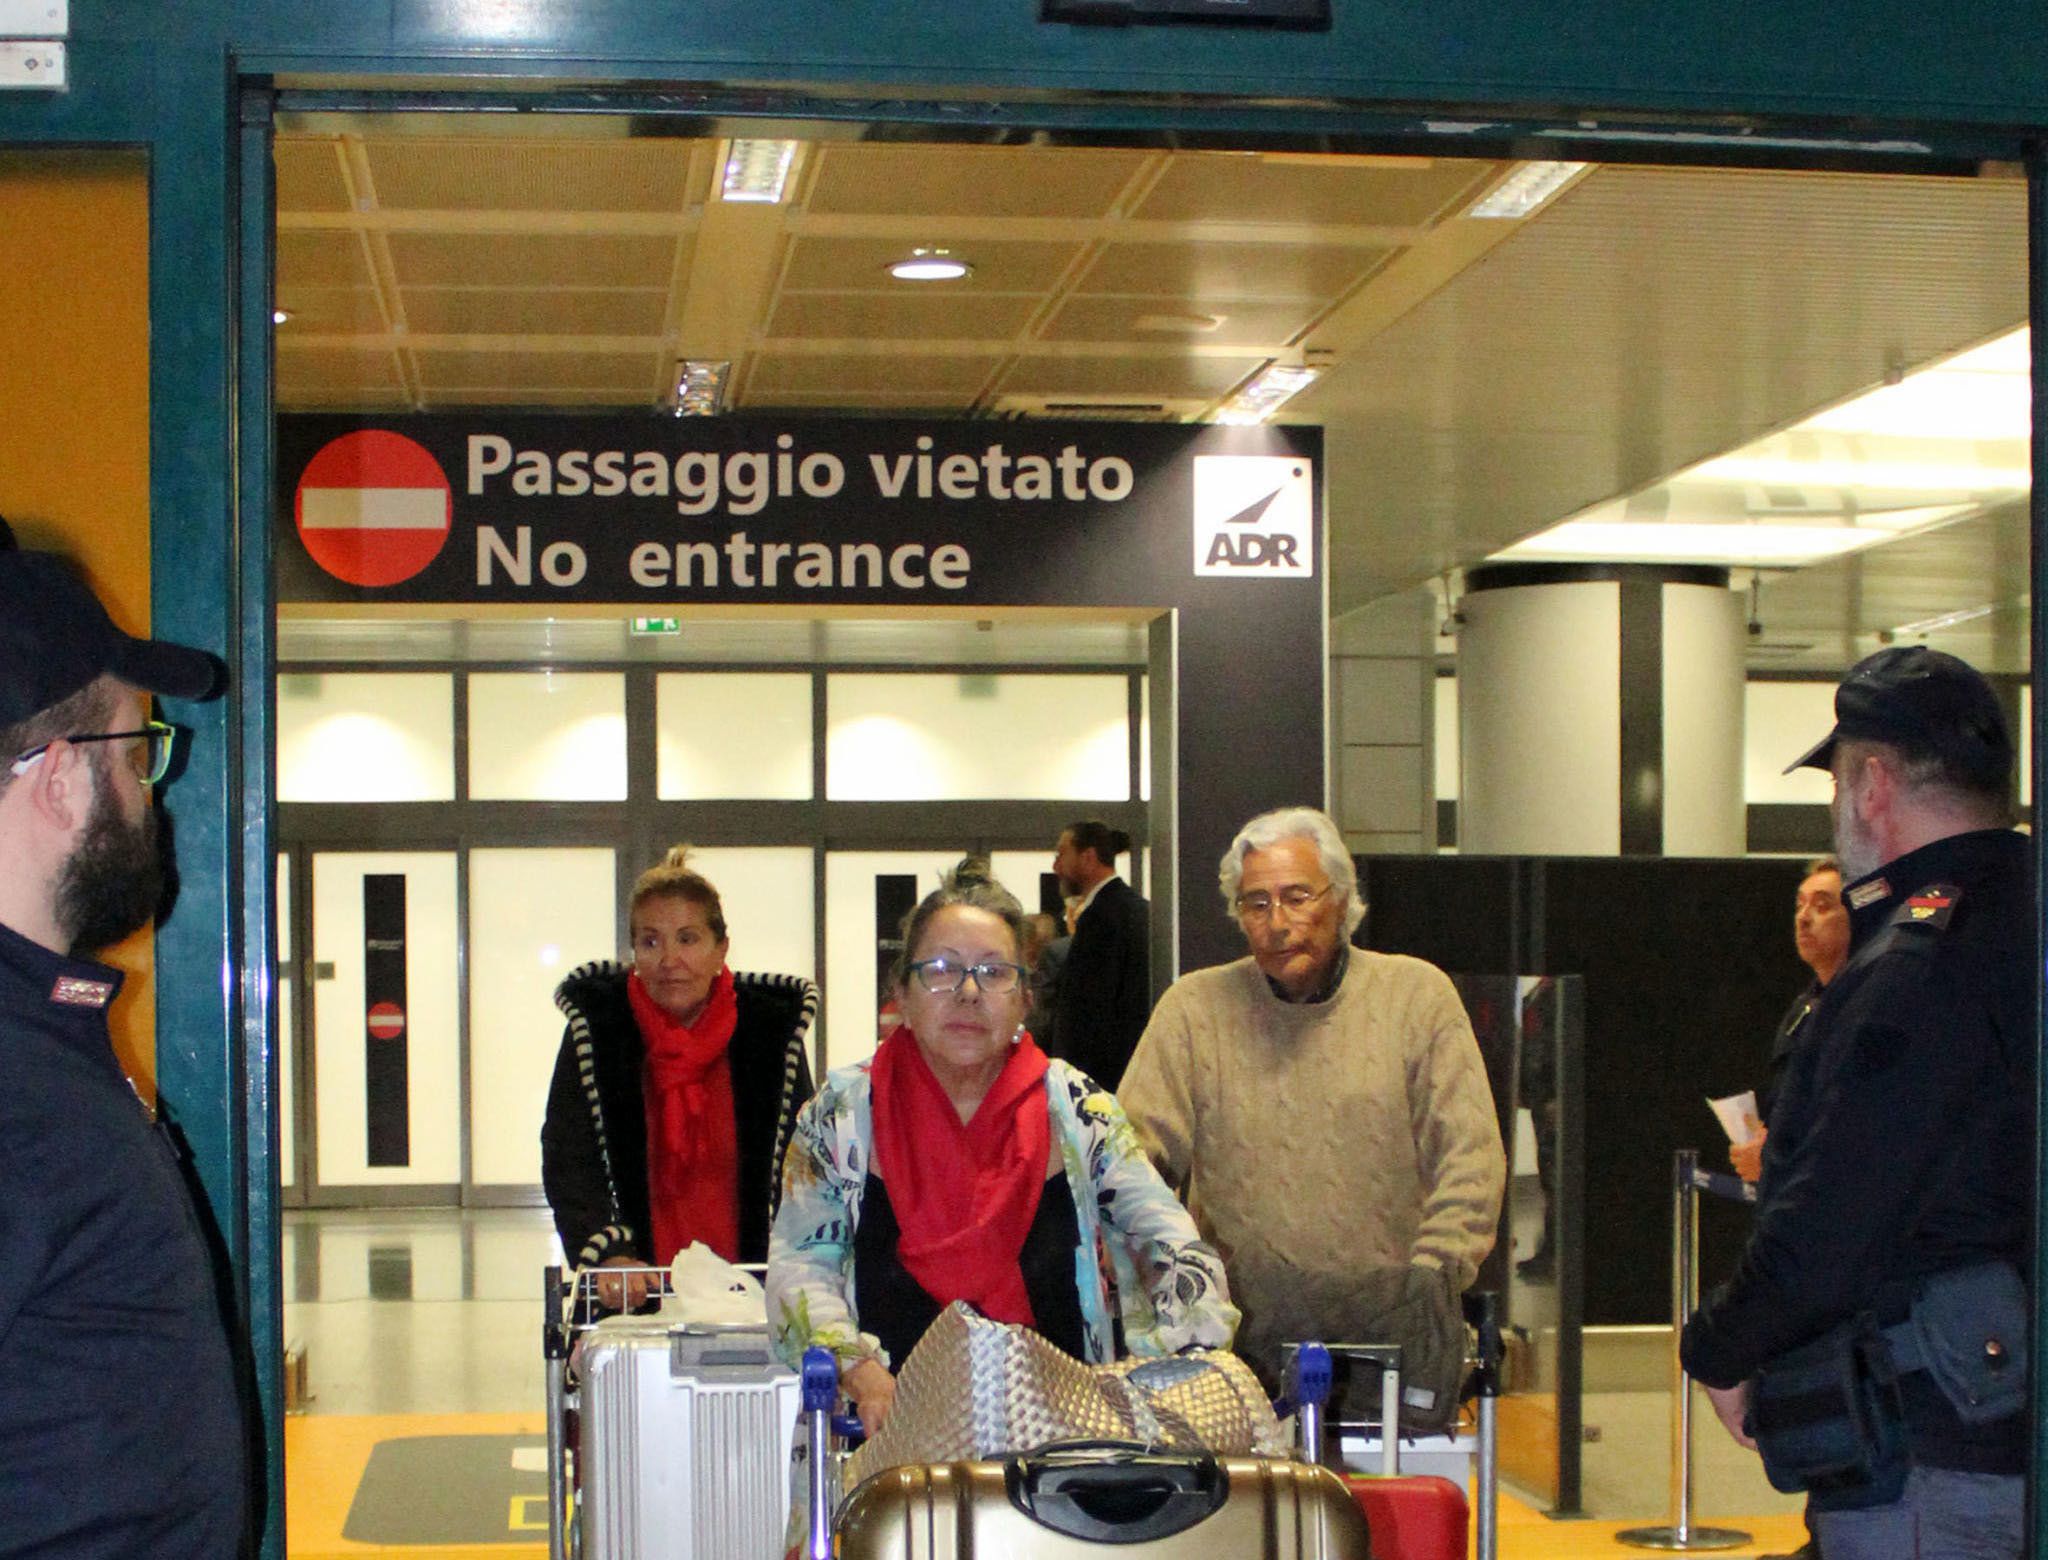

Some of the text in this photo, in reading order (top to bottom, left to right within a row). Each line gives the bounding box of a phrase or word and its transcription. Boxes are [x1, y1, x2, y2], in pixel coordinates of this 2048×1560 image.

[467, 434, 1135, 516] Passaggio vietato
[476, 525, 971, 589] No entrance
[1205, 532, 1300, 568] ADR
